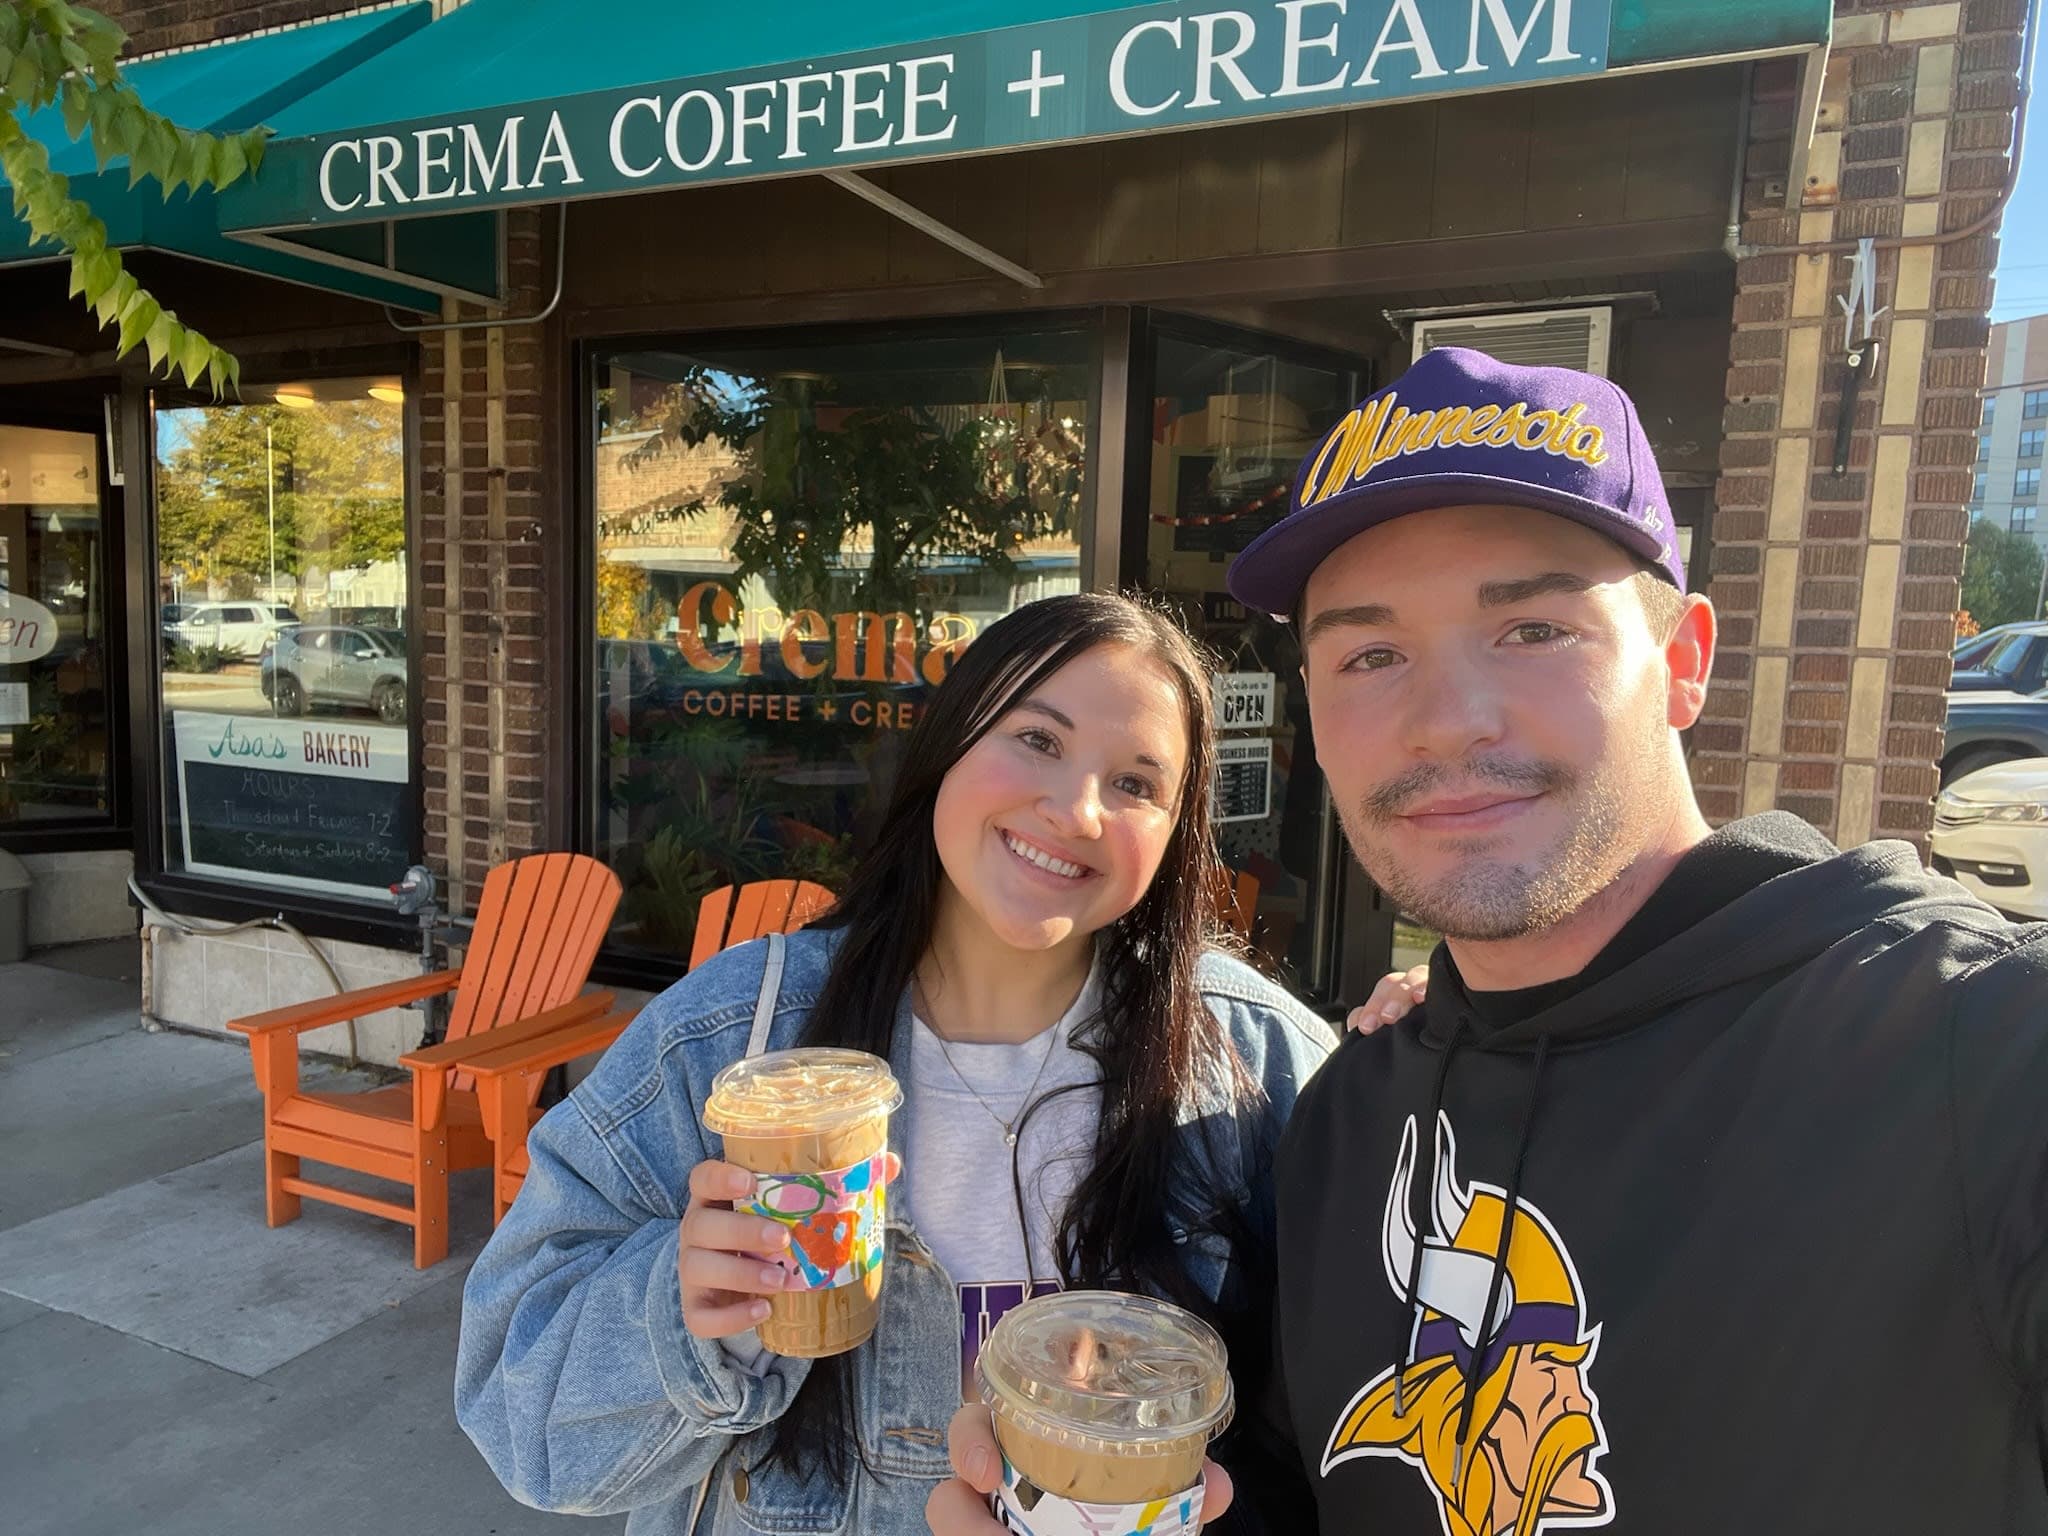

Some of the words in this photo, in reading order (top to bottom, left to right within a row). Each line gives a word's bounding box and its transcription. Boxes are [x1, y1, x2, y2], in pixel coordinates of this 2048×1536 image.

[319, 109, 584, 213] CREMA
[609, 53, 957, 178] COFFEE
[1007, 49, 1065, 118] +
[1109, 0, 1583, 117] CREAM
[1300, 391, 1608, 508] Minnesota
[676, 581, 977, 688] Crema
[683, 690, 800, 722] COFFEE
[817, 699, 837, 721] +
[850, 699, 926, 730] CRE
[1224, 695, 1265, 723] OPEN
[208, 718, 287, 760] Asa's
[303, 731, 371, 769] BAKERY
[1218, 747, 1246, 760] USINESS
